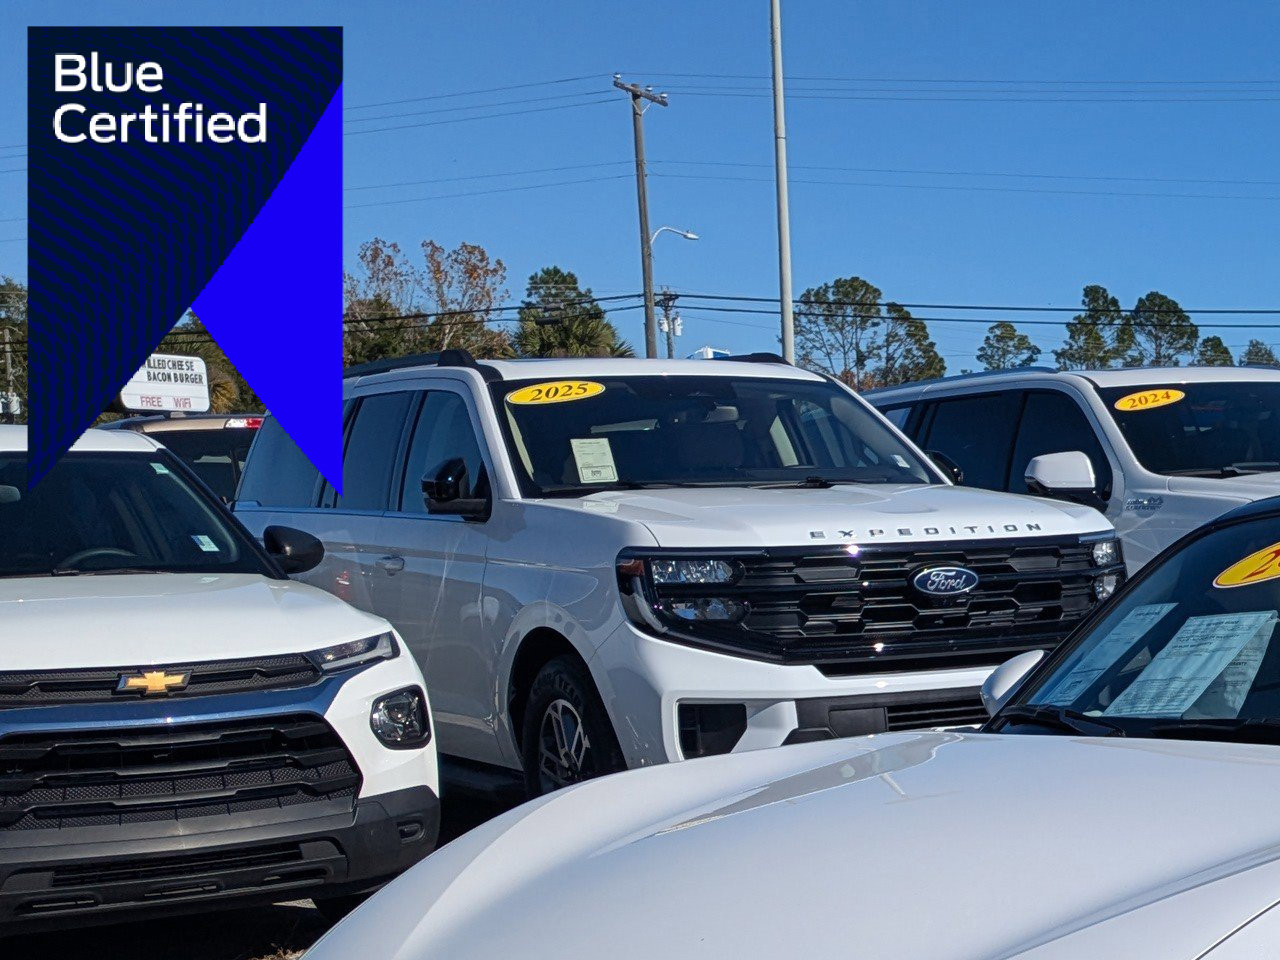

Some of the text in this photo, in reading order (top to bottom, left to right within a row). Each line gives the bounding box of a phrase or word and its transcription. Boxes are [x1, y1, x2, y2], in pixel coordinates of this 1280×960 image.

[147, 371, 204, 385] BACON BURGER
[529, 382, 589, 402] 2025
[1127, 390, 1172, 410] 2024
[140, 396, 163, 408] FREE
[808, 523, 1042, 540] EXPEDITION
[926, 570, 967, 591] Ford
